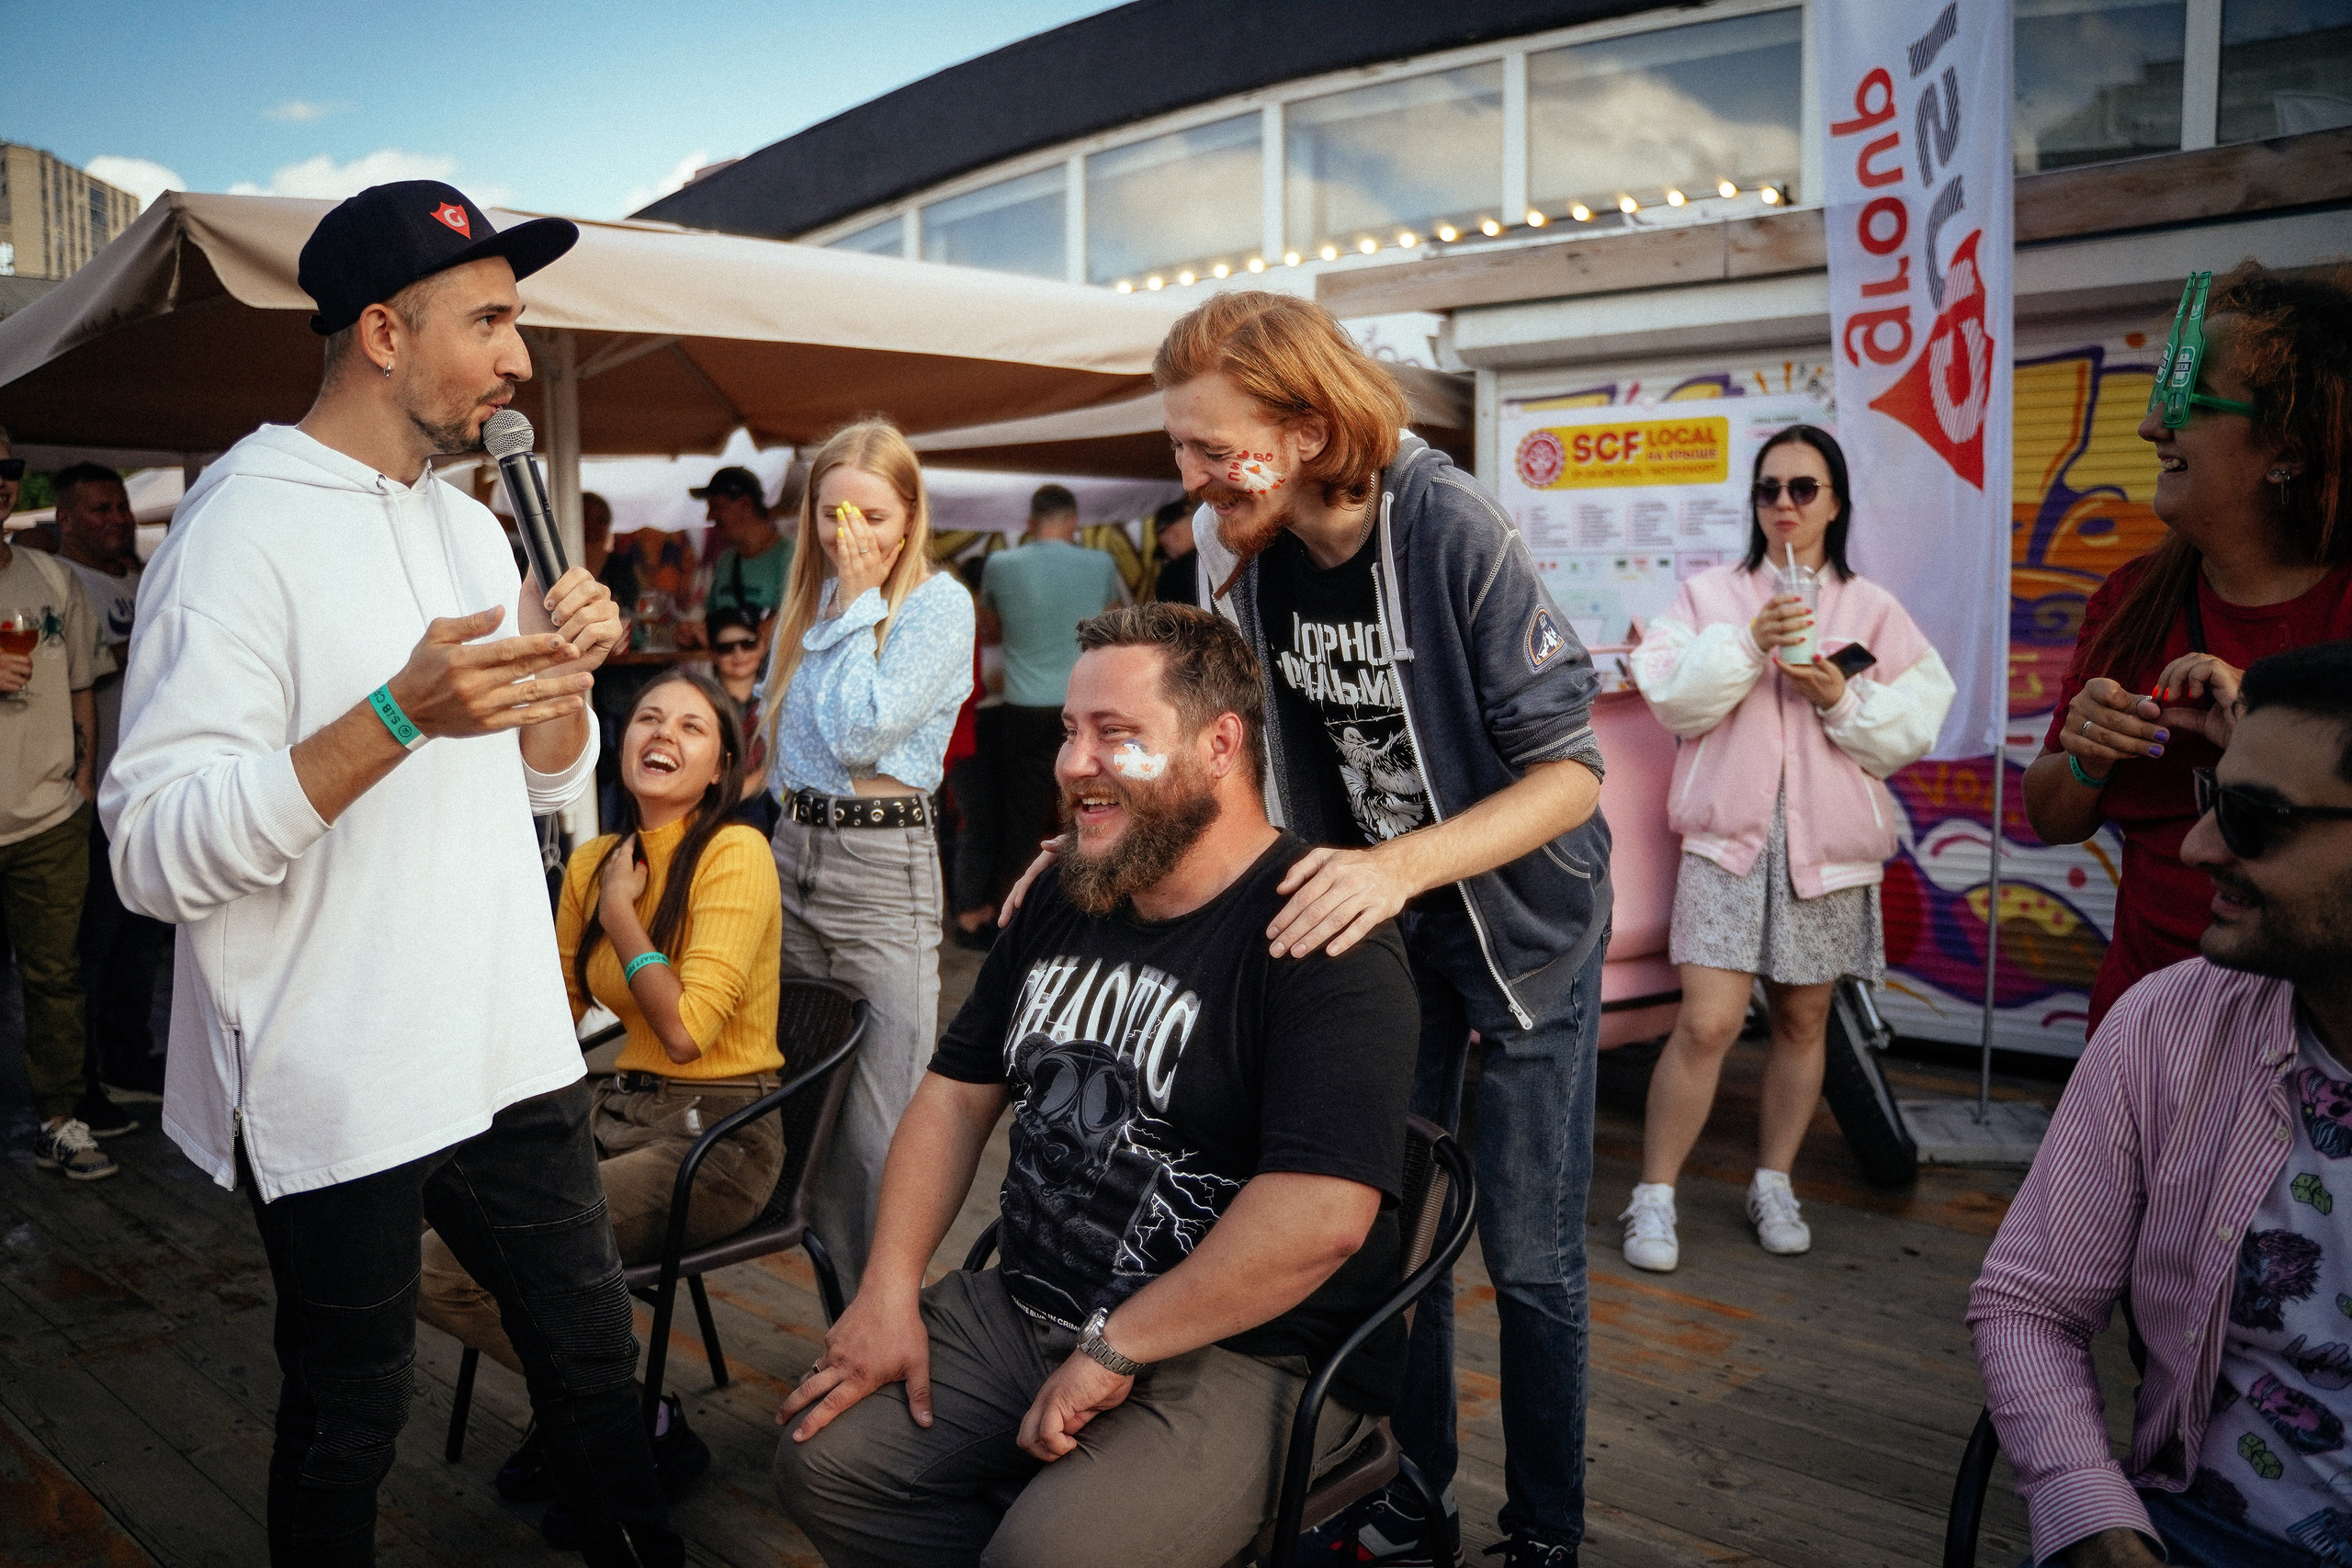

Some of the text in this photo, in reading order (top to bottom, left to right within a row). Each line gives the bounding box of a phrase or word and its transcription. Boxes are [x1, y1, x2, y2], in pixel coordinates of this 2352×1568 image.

[443, 209, 467, 228] G
[1572, 426, 1716, 466] SCF LOCAL
[382, 704, 401, 725] SIB
[1003, 955, 1203, 1113] CHAOTIC
[1057, 1318, 1080, 1332] CRIM
